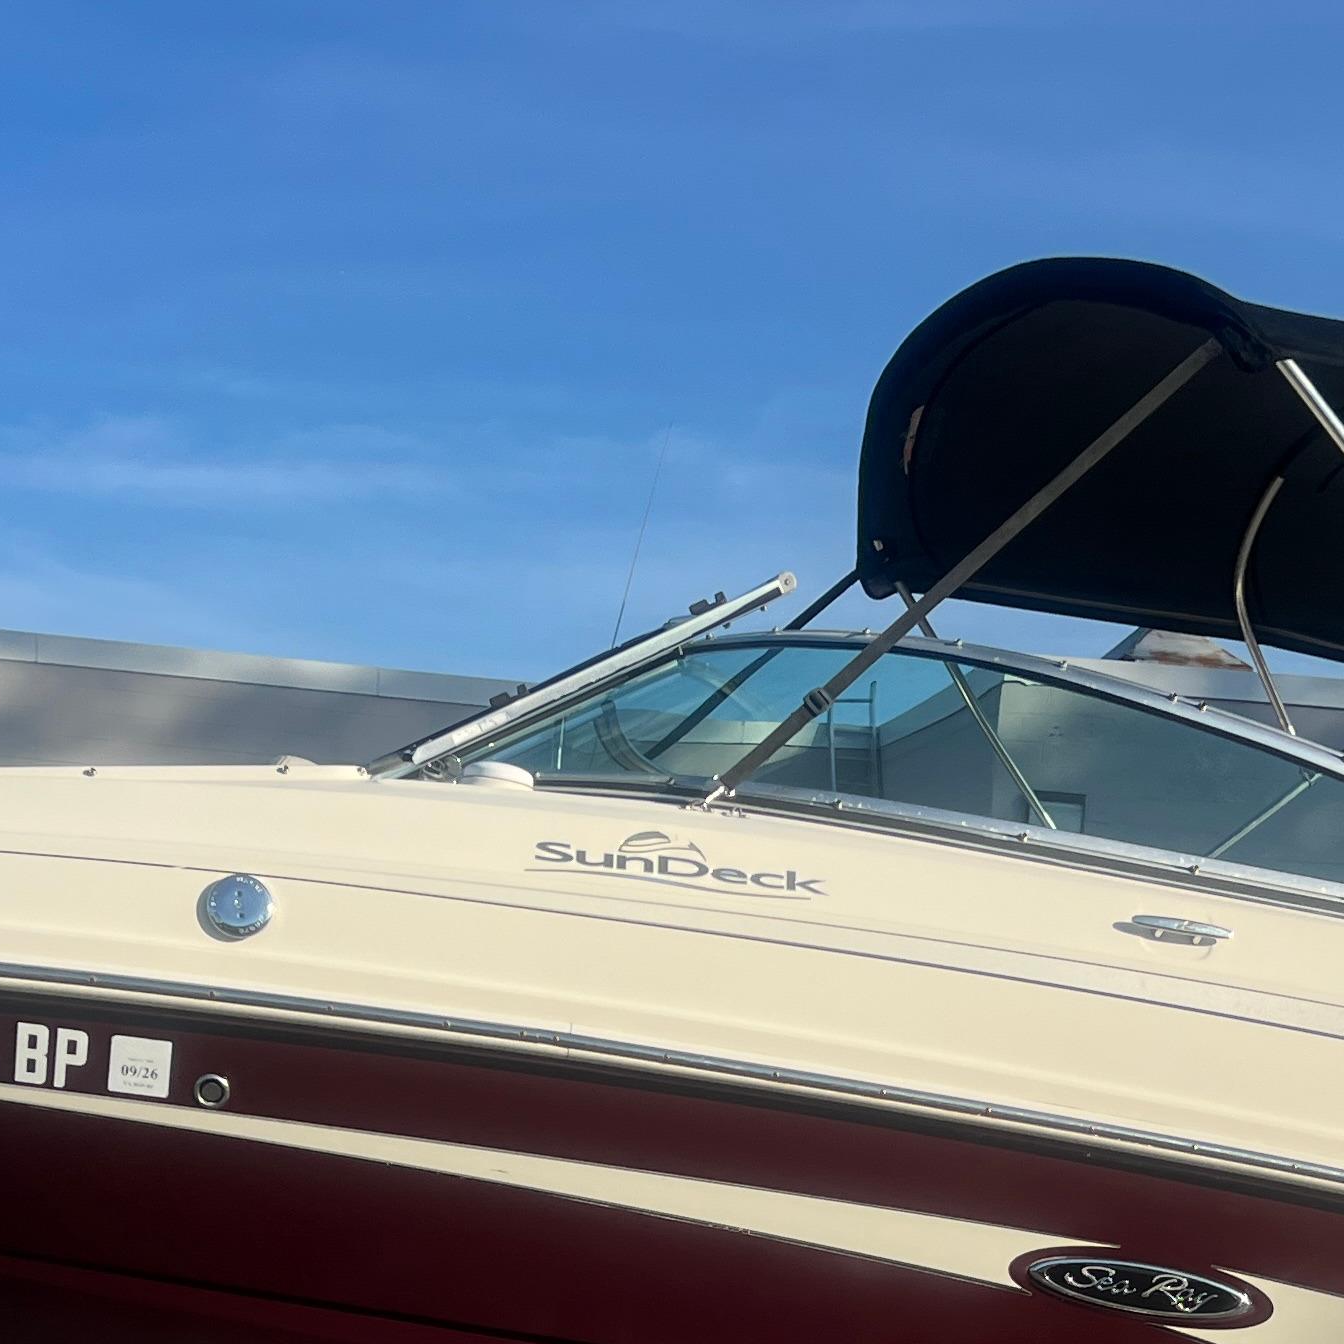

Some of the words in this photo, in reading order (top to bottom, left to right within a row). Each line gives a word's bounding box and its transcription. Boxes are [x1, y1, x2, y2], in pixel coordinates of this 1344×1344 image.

[535, 841, 829, 896] SunDeck
[14, 1021, 89, 1089] BP
[121, 1064, 159, 1081] 09/26
[1064, 1266, 1137, 1295] Sea
[1141, 1274, 1218, 1313] Ray
